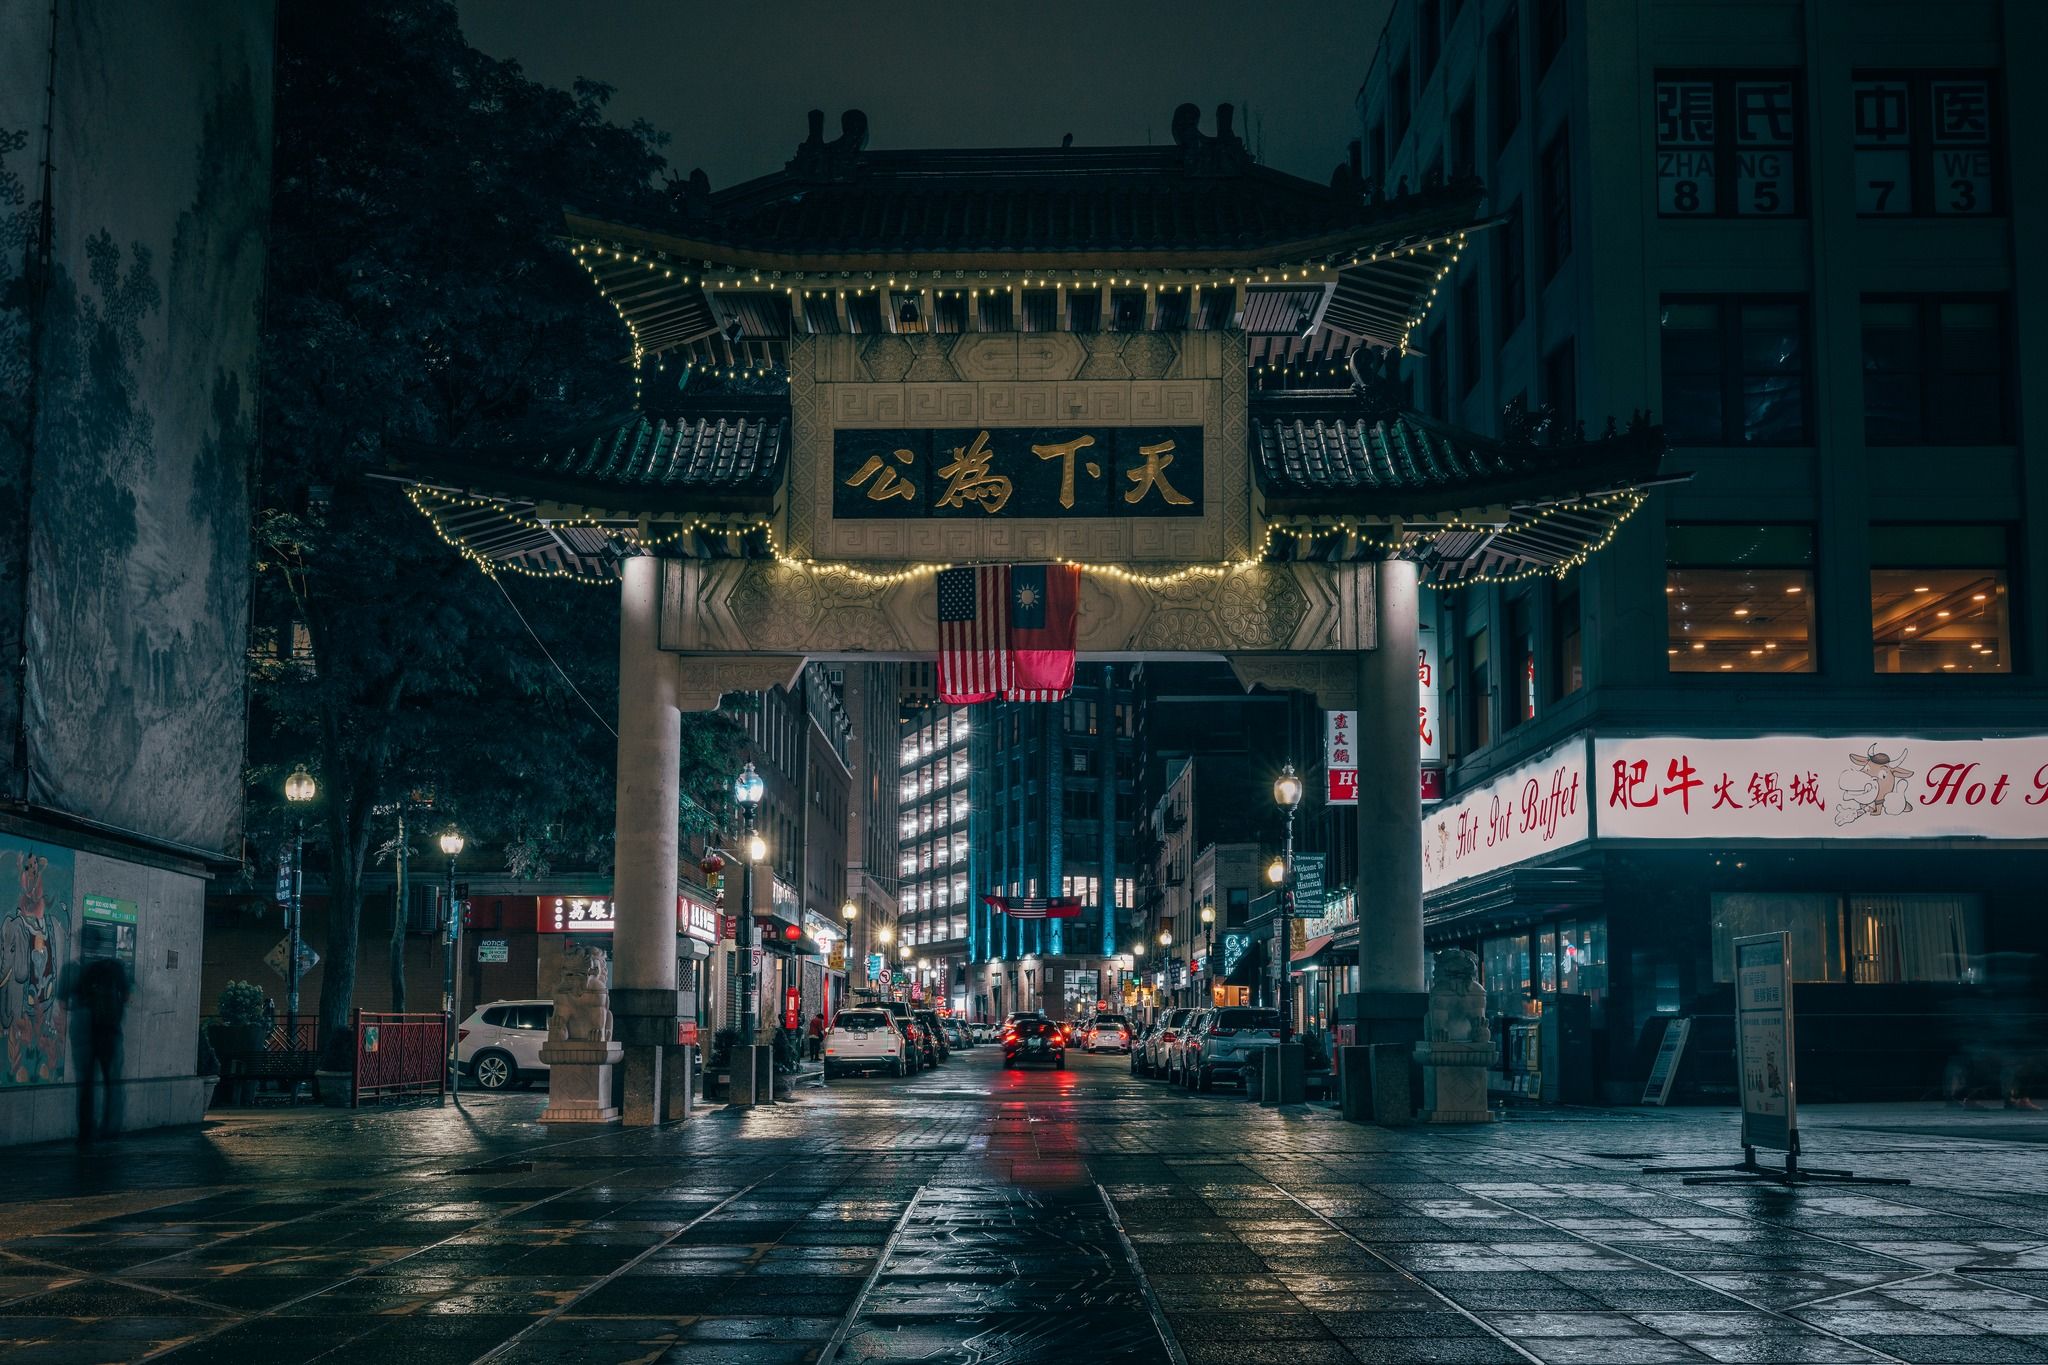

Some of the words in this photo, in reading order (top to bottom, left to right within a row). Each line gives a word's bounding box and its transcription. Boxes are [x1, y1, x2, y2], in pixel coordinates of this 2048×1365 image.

[1673, 180, 1700, 212] 8
[1753, 182, 1780, 212] 5
[1868, 181, 1895, 212] 7
[1950, 180, 1977, 212] 3
[1609, 755, 1826, 815] 肥牛火鍋城
[1919, 762, 2010, 806] Hot
[1456, 807, 1479, 860] Hot
[1487, 795, 1513, 848] Pot
[1519, 766, 1579, 842] Buffet
[1294, 864, 1317, 873] Welcome
[1316, 861, 1323, 870] To
[1295, 888, 1322, 899] Chinatown
[1297, 879, 1322, 890] Historical
